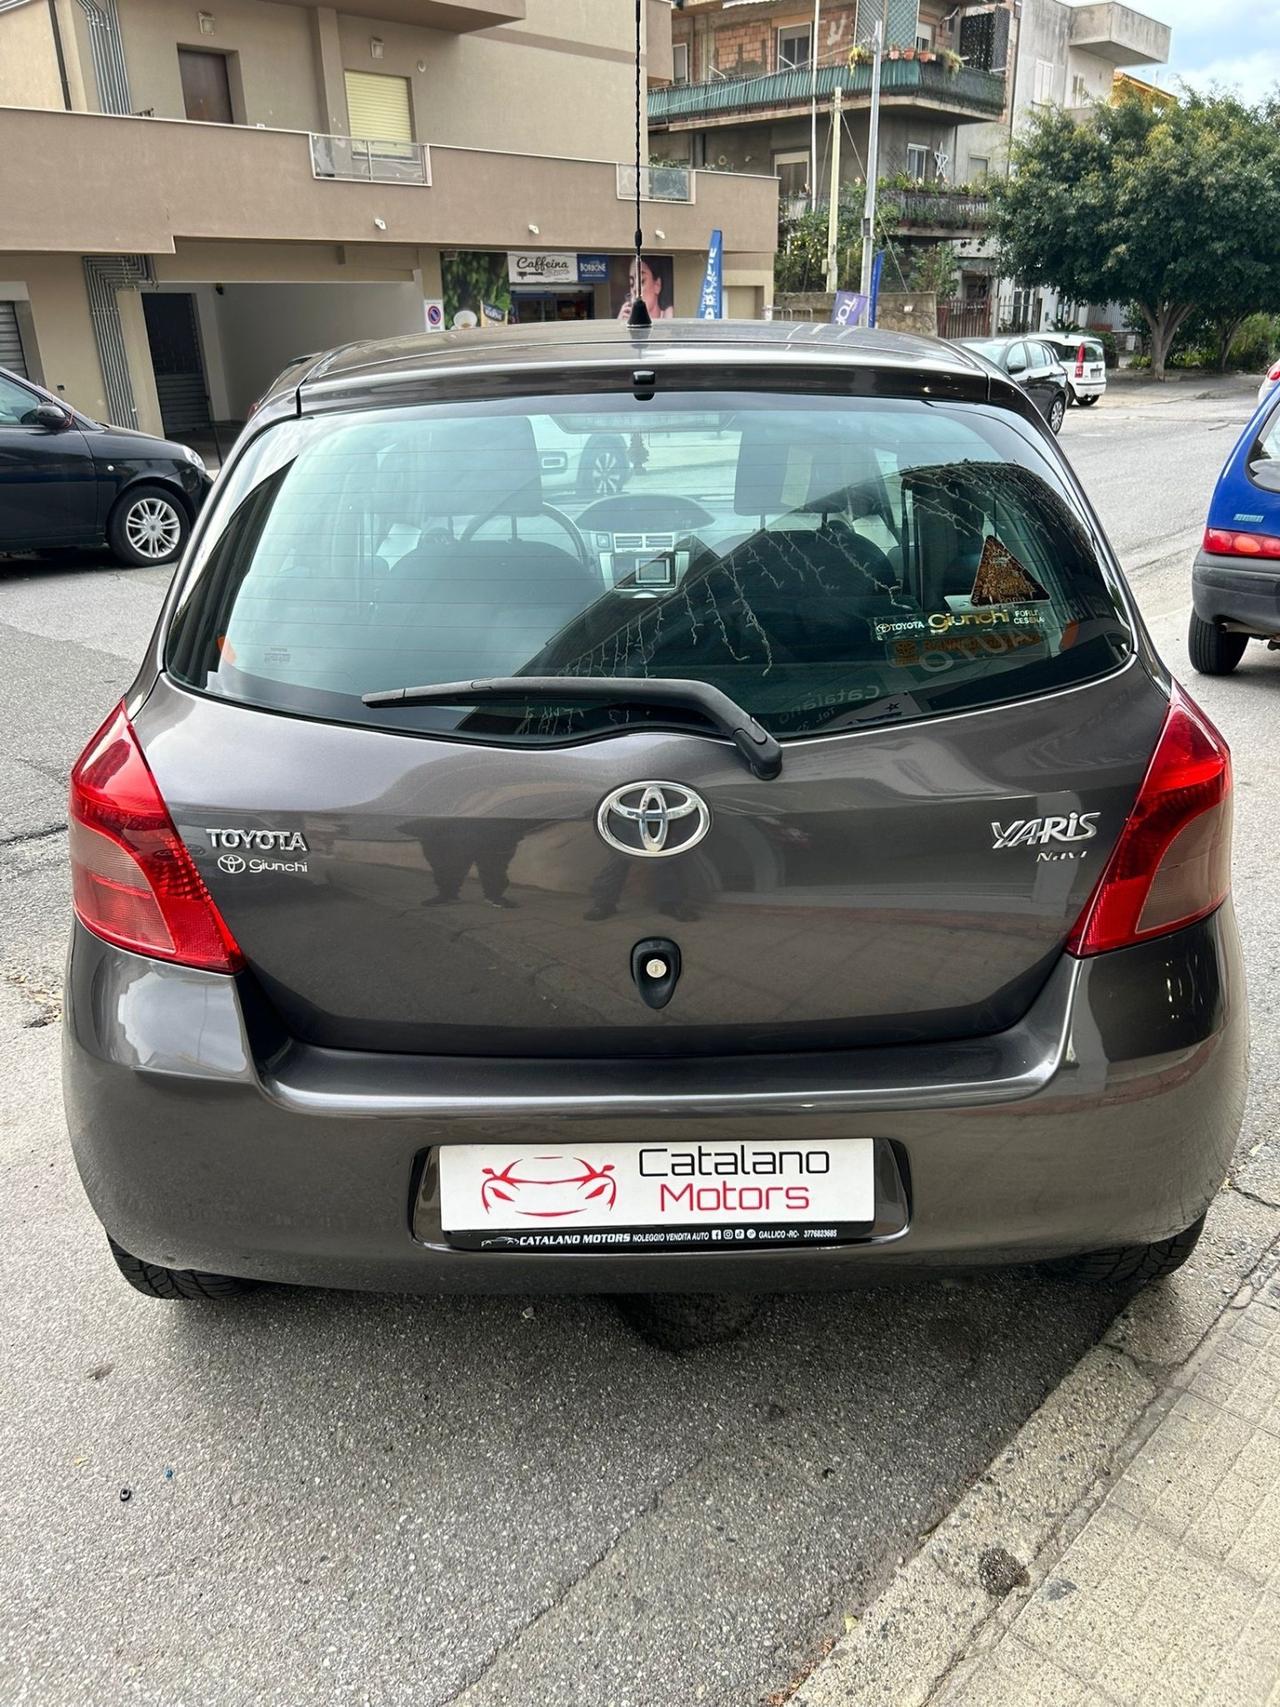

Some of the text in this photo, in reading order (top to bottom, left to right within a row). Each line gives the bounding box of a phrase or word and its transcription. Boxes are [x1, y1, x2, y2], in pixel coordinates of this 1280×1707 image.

[516, 255, 569, 271] Caffeina
[890, 620, 925, 632] TOYOTA
[205, 828, 310, 852] TOYOTA
[638, 1143, 830, 1177] Catalano
[659, 1180, 810, 1212] Motors
[519, 1234, 581, 1246] CATALANO
[582, 1233, 631, 1244] MOTORS
[632, 1233, 665, 1243] NOLEGGIO
[666, 1232, 691, 1242] VENDITA
[691, 1231, 710, 1240] AUTO
[758, 1230, 786, 1239] GALLICO
